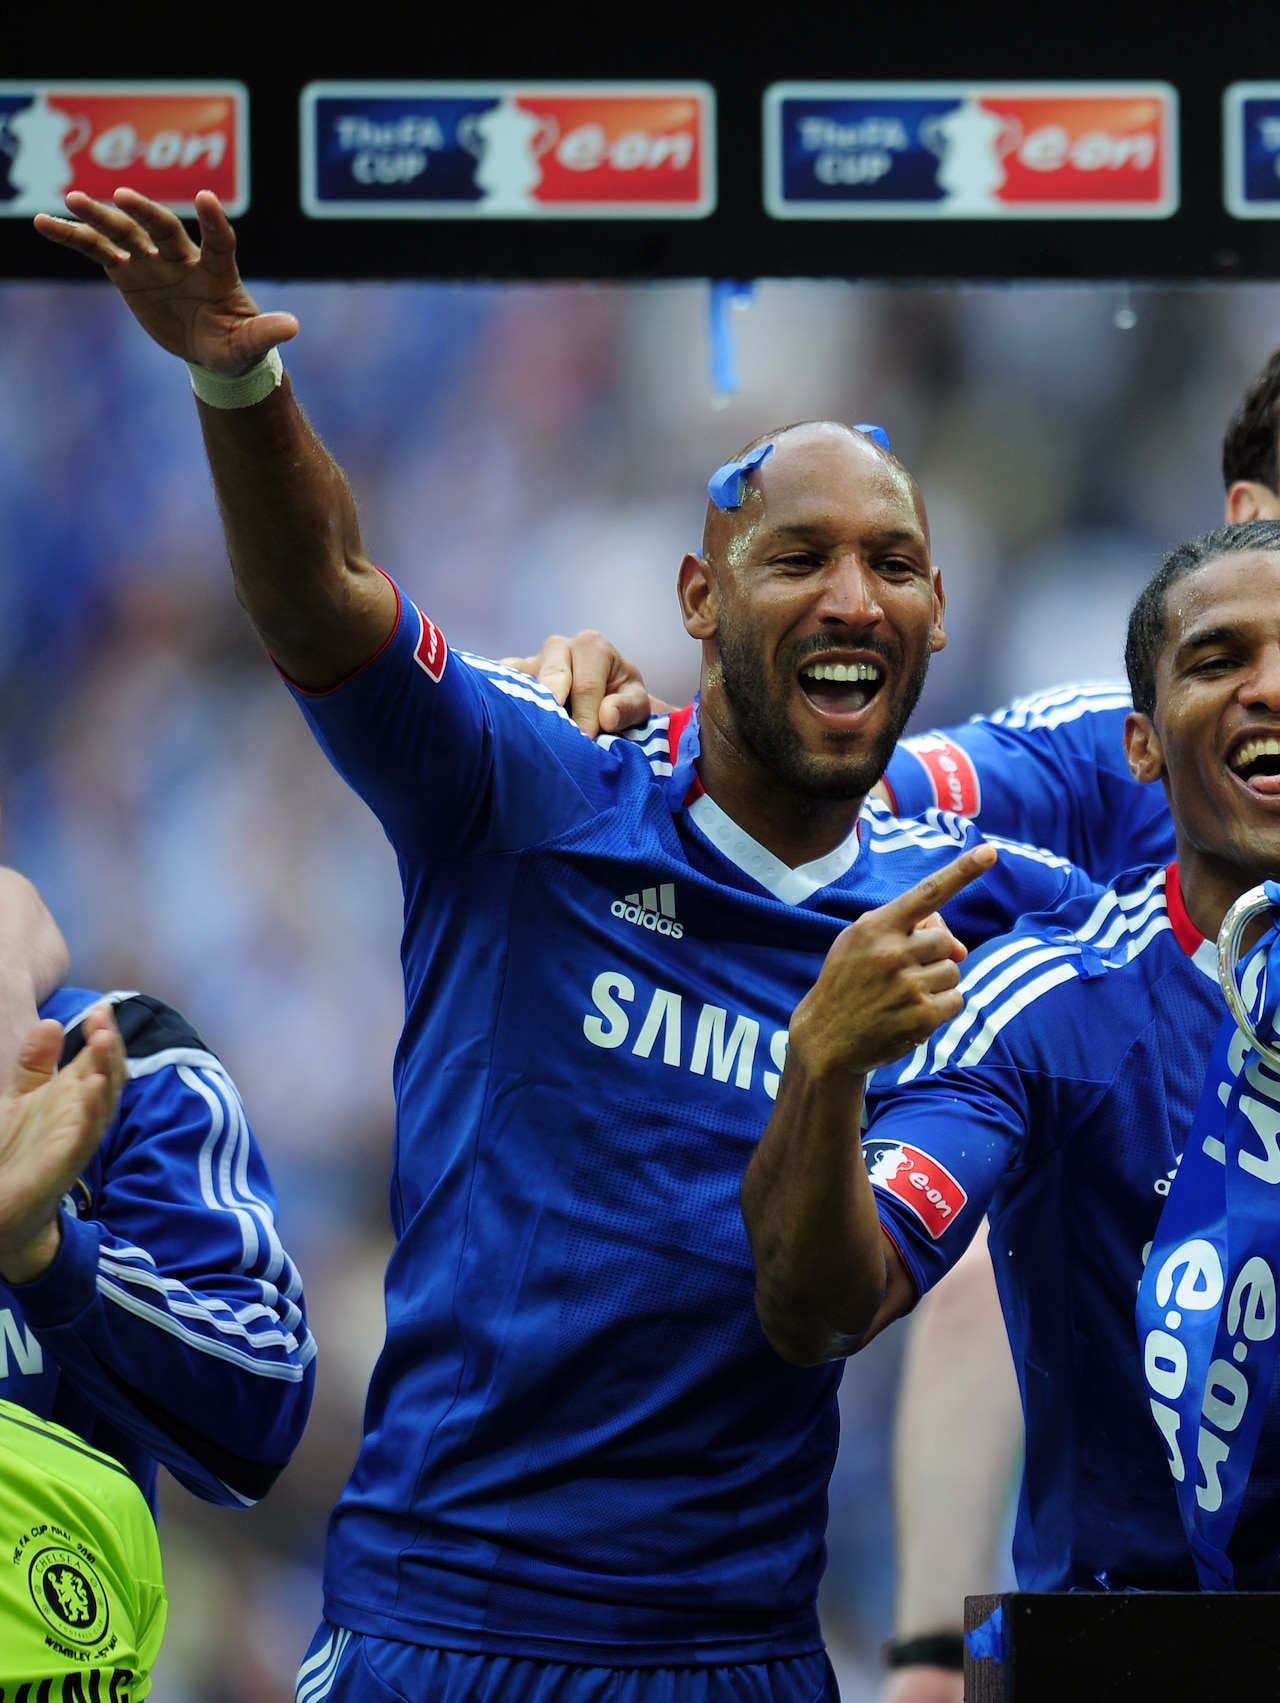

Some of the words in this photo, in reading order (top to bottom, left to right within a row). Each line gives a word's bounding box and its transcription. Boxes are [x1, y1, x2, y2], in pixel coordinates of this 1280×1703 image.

[352, 151, 428, 184] CUP
[814, 150, 892, 185] CUP
[611, 900, 684, 939] adidas
[19, 1535, 31, 1548] FA
[31, 1525, 48, 1538] CUP
[35, 1552, 82, 1574] CHELSEA
[44, 1635, 91, 1662] WEMBLEY
